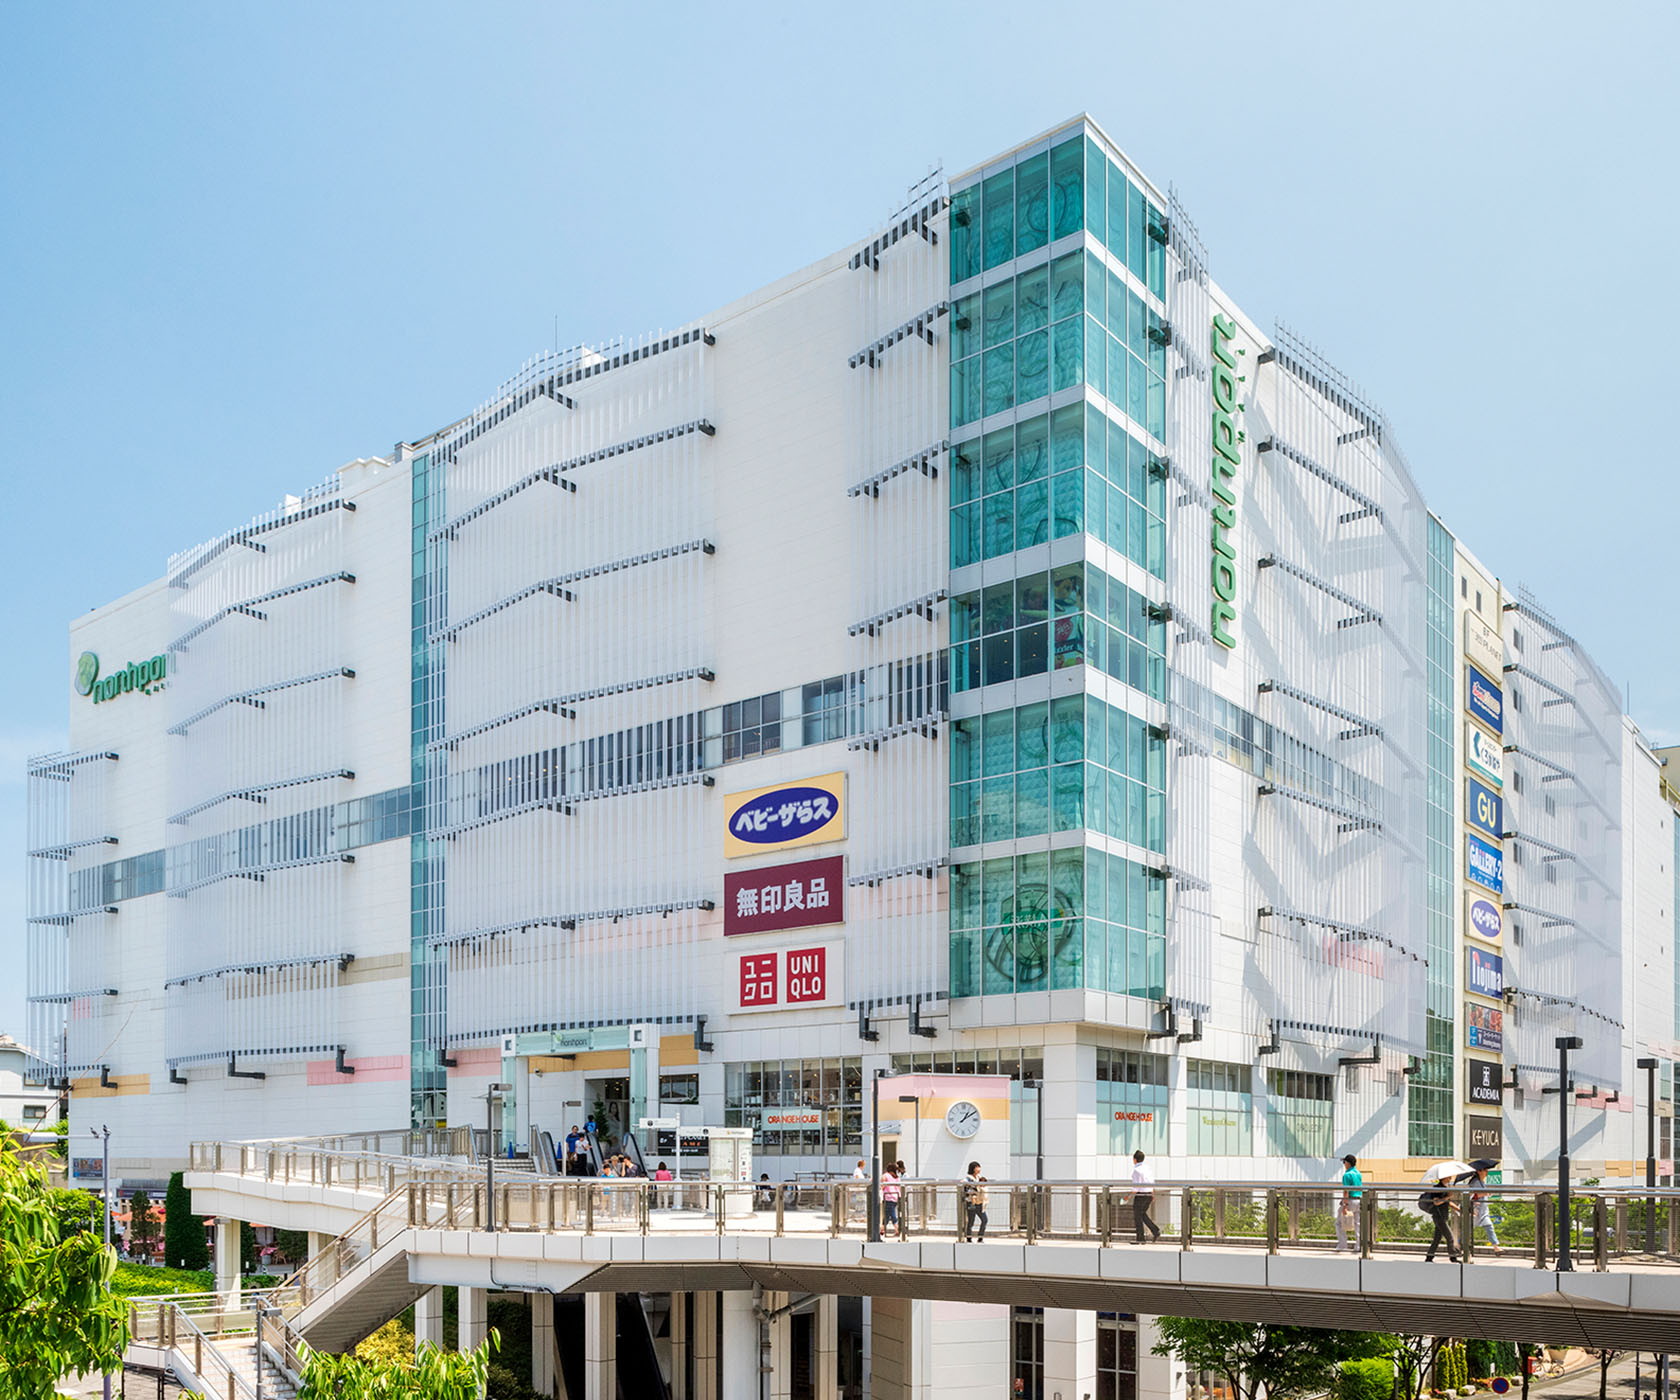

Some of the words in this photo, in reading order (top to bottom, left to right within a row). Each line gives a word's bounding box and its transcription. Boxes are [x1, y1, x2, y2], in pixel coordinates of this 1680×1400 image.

[1212, 313, 1241, 649] northport
[735, 796, 832, 832] ベビーザらス
[1477, 791, 1496, 828] GU
[736, 877, 830, 918] 無印良品
[790, 954, 819, 975] UNI
[790, 976, 822, 999] QLO
[1472, 1086, 1500, 1101] ACADEMIA
[1472, 1129, 1500, 1146] KEYUCA
